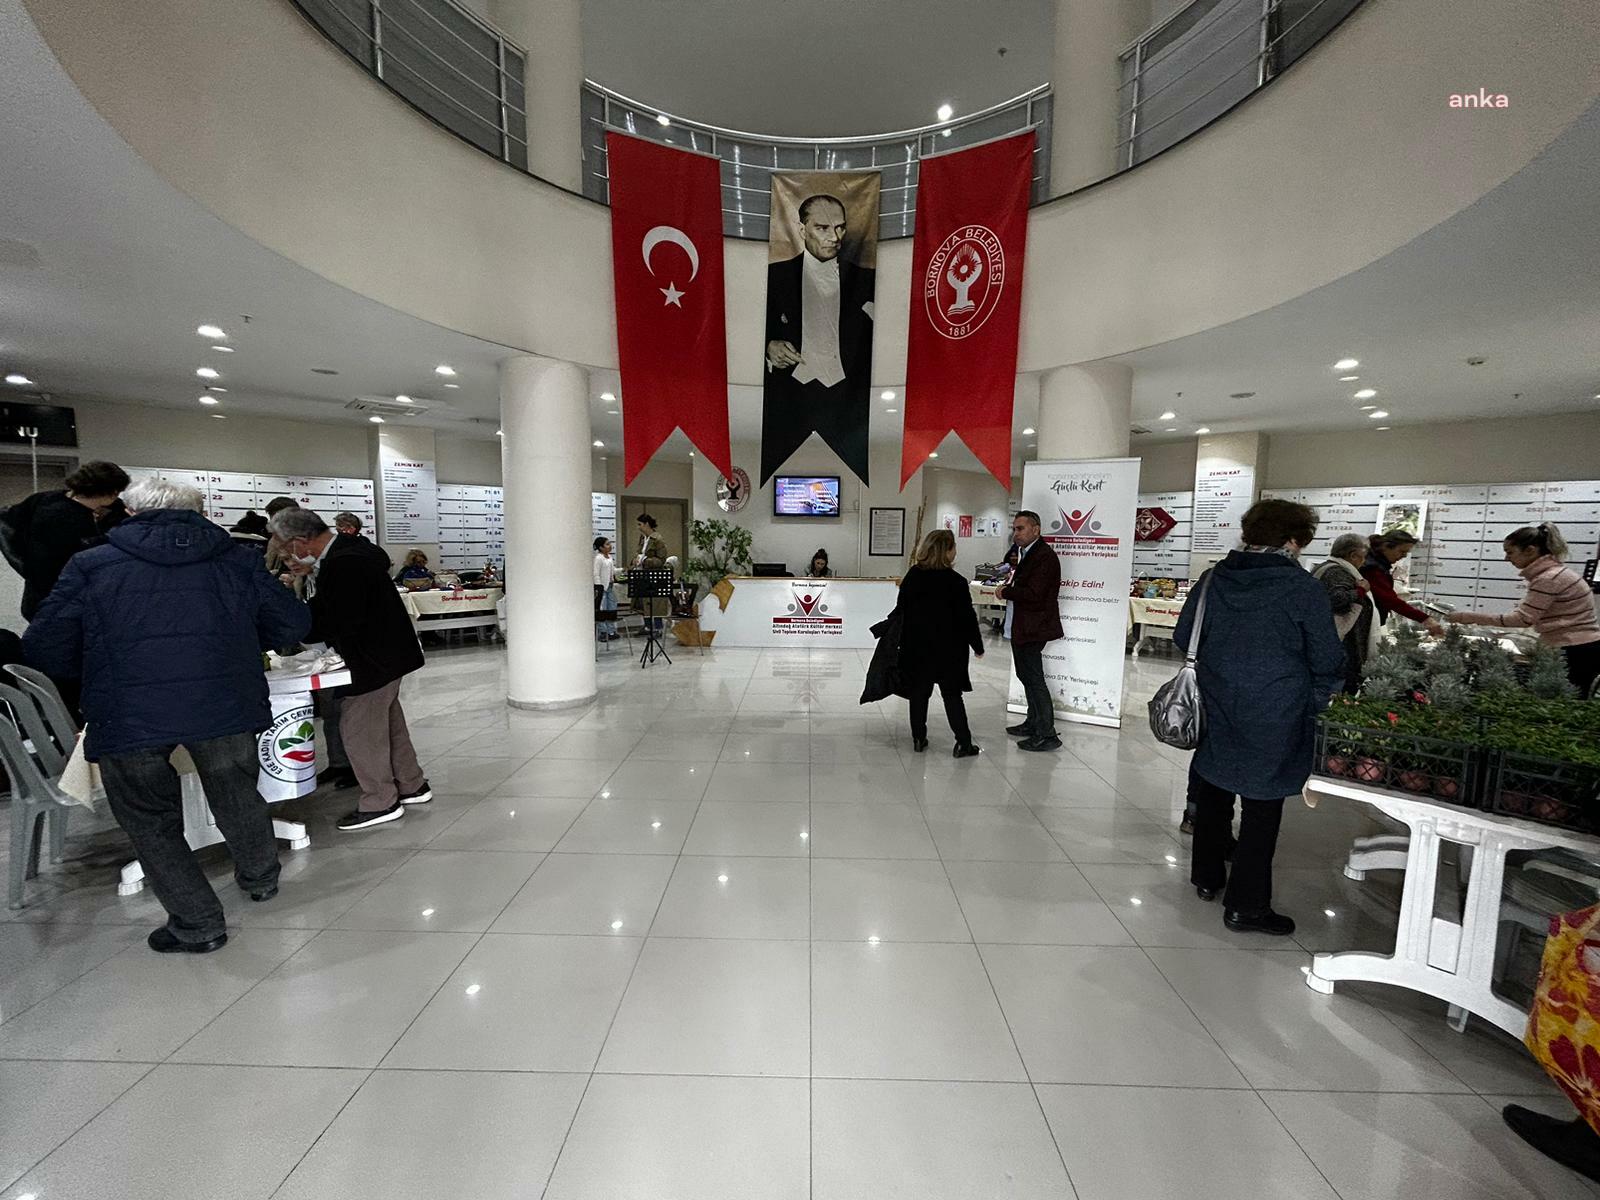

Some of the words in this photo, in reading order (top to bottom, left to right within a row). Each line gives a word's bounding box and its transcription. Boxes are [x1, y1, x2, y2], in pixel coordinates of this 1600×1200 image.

[927, 235, 961, 298] BORNOVA
[949, 324, 971, 336] 1881
[1050, 480, 1078, 495] Güçlü
[1080, 479, 1107, 493] Kent
[1060, 580, 1080, 589] akip
[1081, 580, 1105, 589] Edin!
[291, 708, 313, 720] ÇEVR
[264, 716, 290, 737] TARIM
[261, 738, 272, 763] KADIN
[266, 761, 283, 775] EGE
